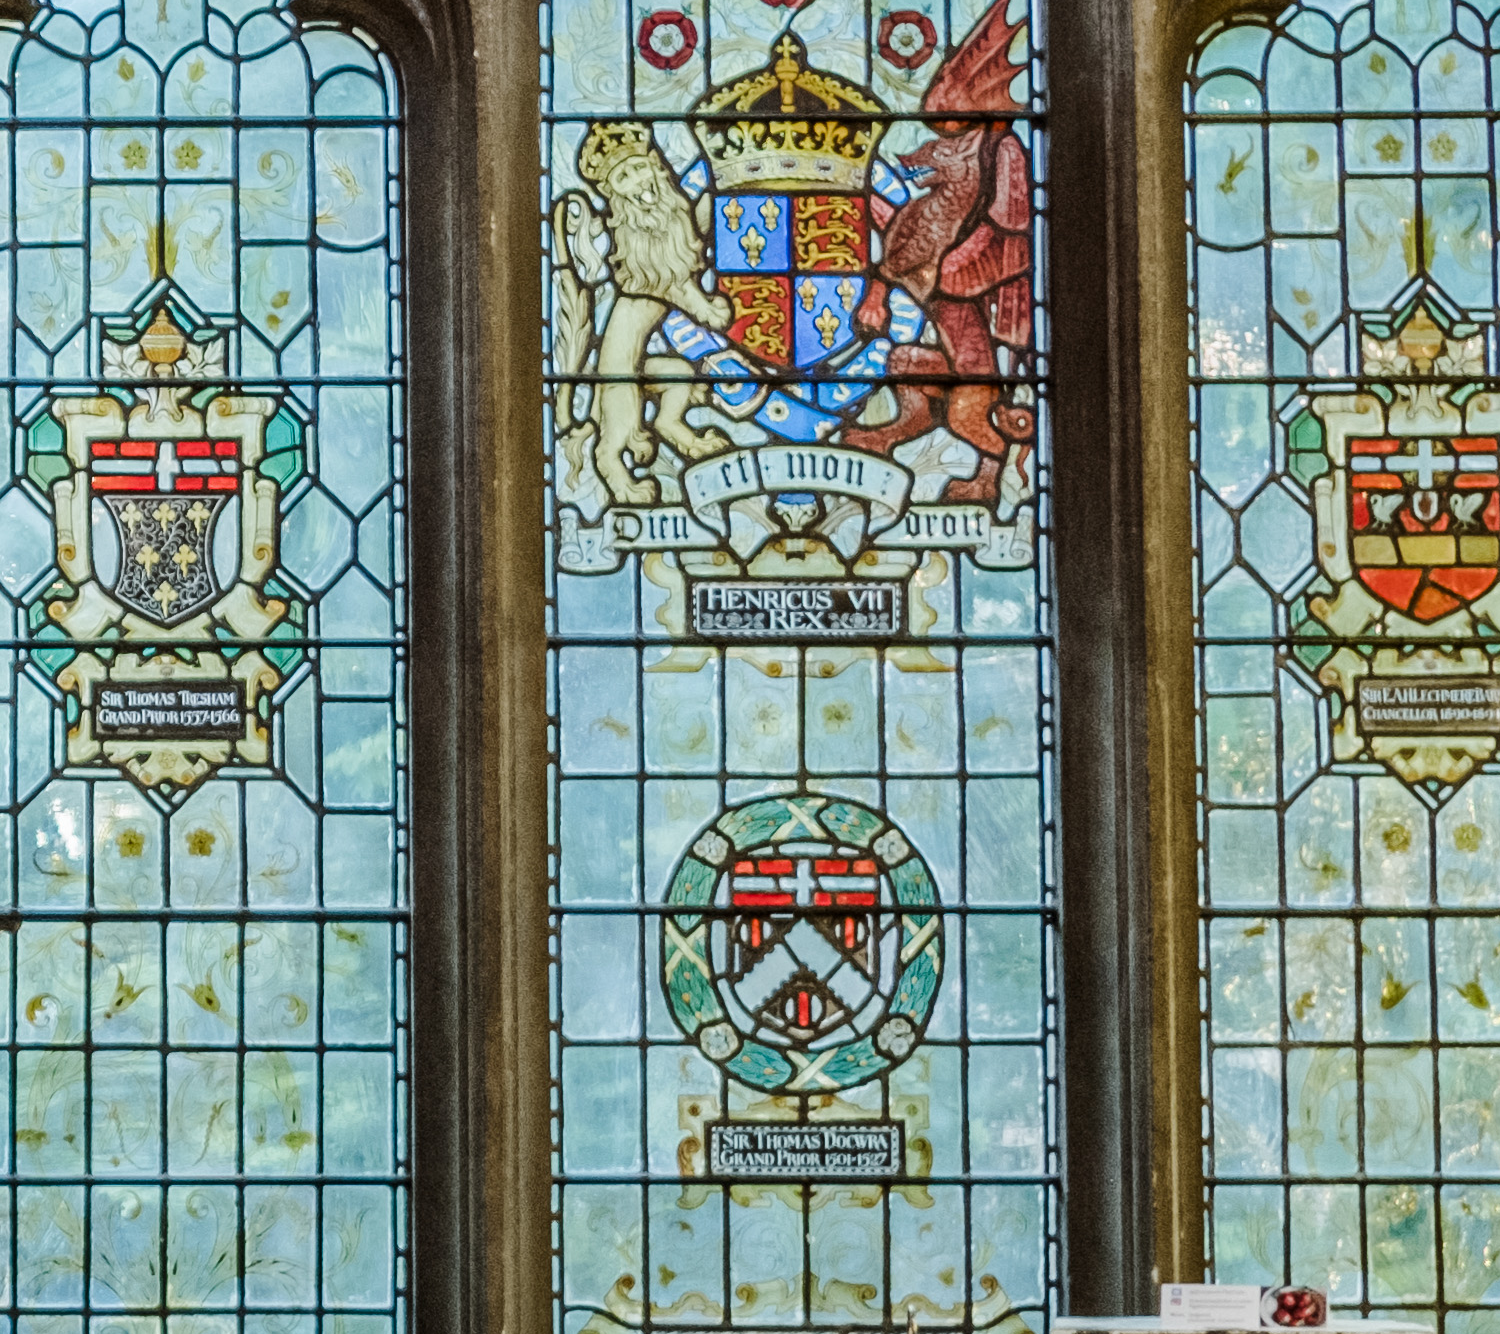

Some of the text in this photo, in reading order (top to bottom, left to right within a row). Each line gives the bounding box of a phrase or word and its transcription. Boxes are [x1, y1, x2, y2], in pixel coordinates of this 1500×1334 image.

[720, 451, 864, 488] et mon
[612, 510, 690, 543] Dieu
[905, 510, 985, 538] droit
[707, 588, 885, 610] HENRICUS VII
[769, 609, 826, 631] REX
[101, 690, 236, 707] SIR THOMAS TRESHAM
[100, 709, 140, 725] GRAND
[141, 709, 180, 725] PRIOR
[722, 1130, 889, 1150] SIR THOMAS DOCWRA
[721, 1150, 775, 1167] GRAND
[777, 1150, 819, 1167] PRIOR
